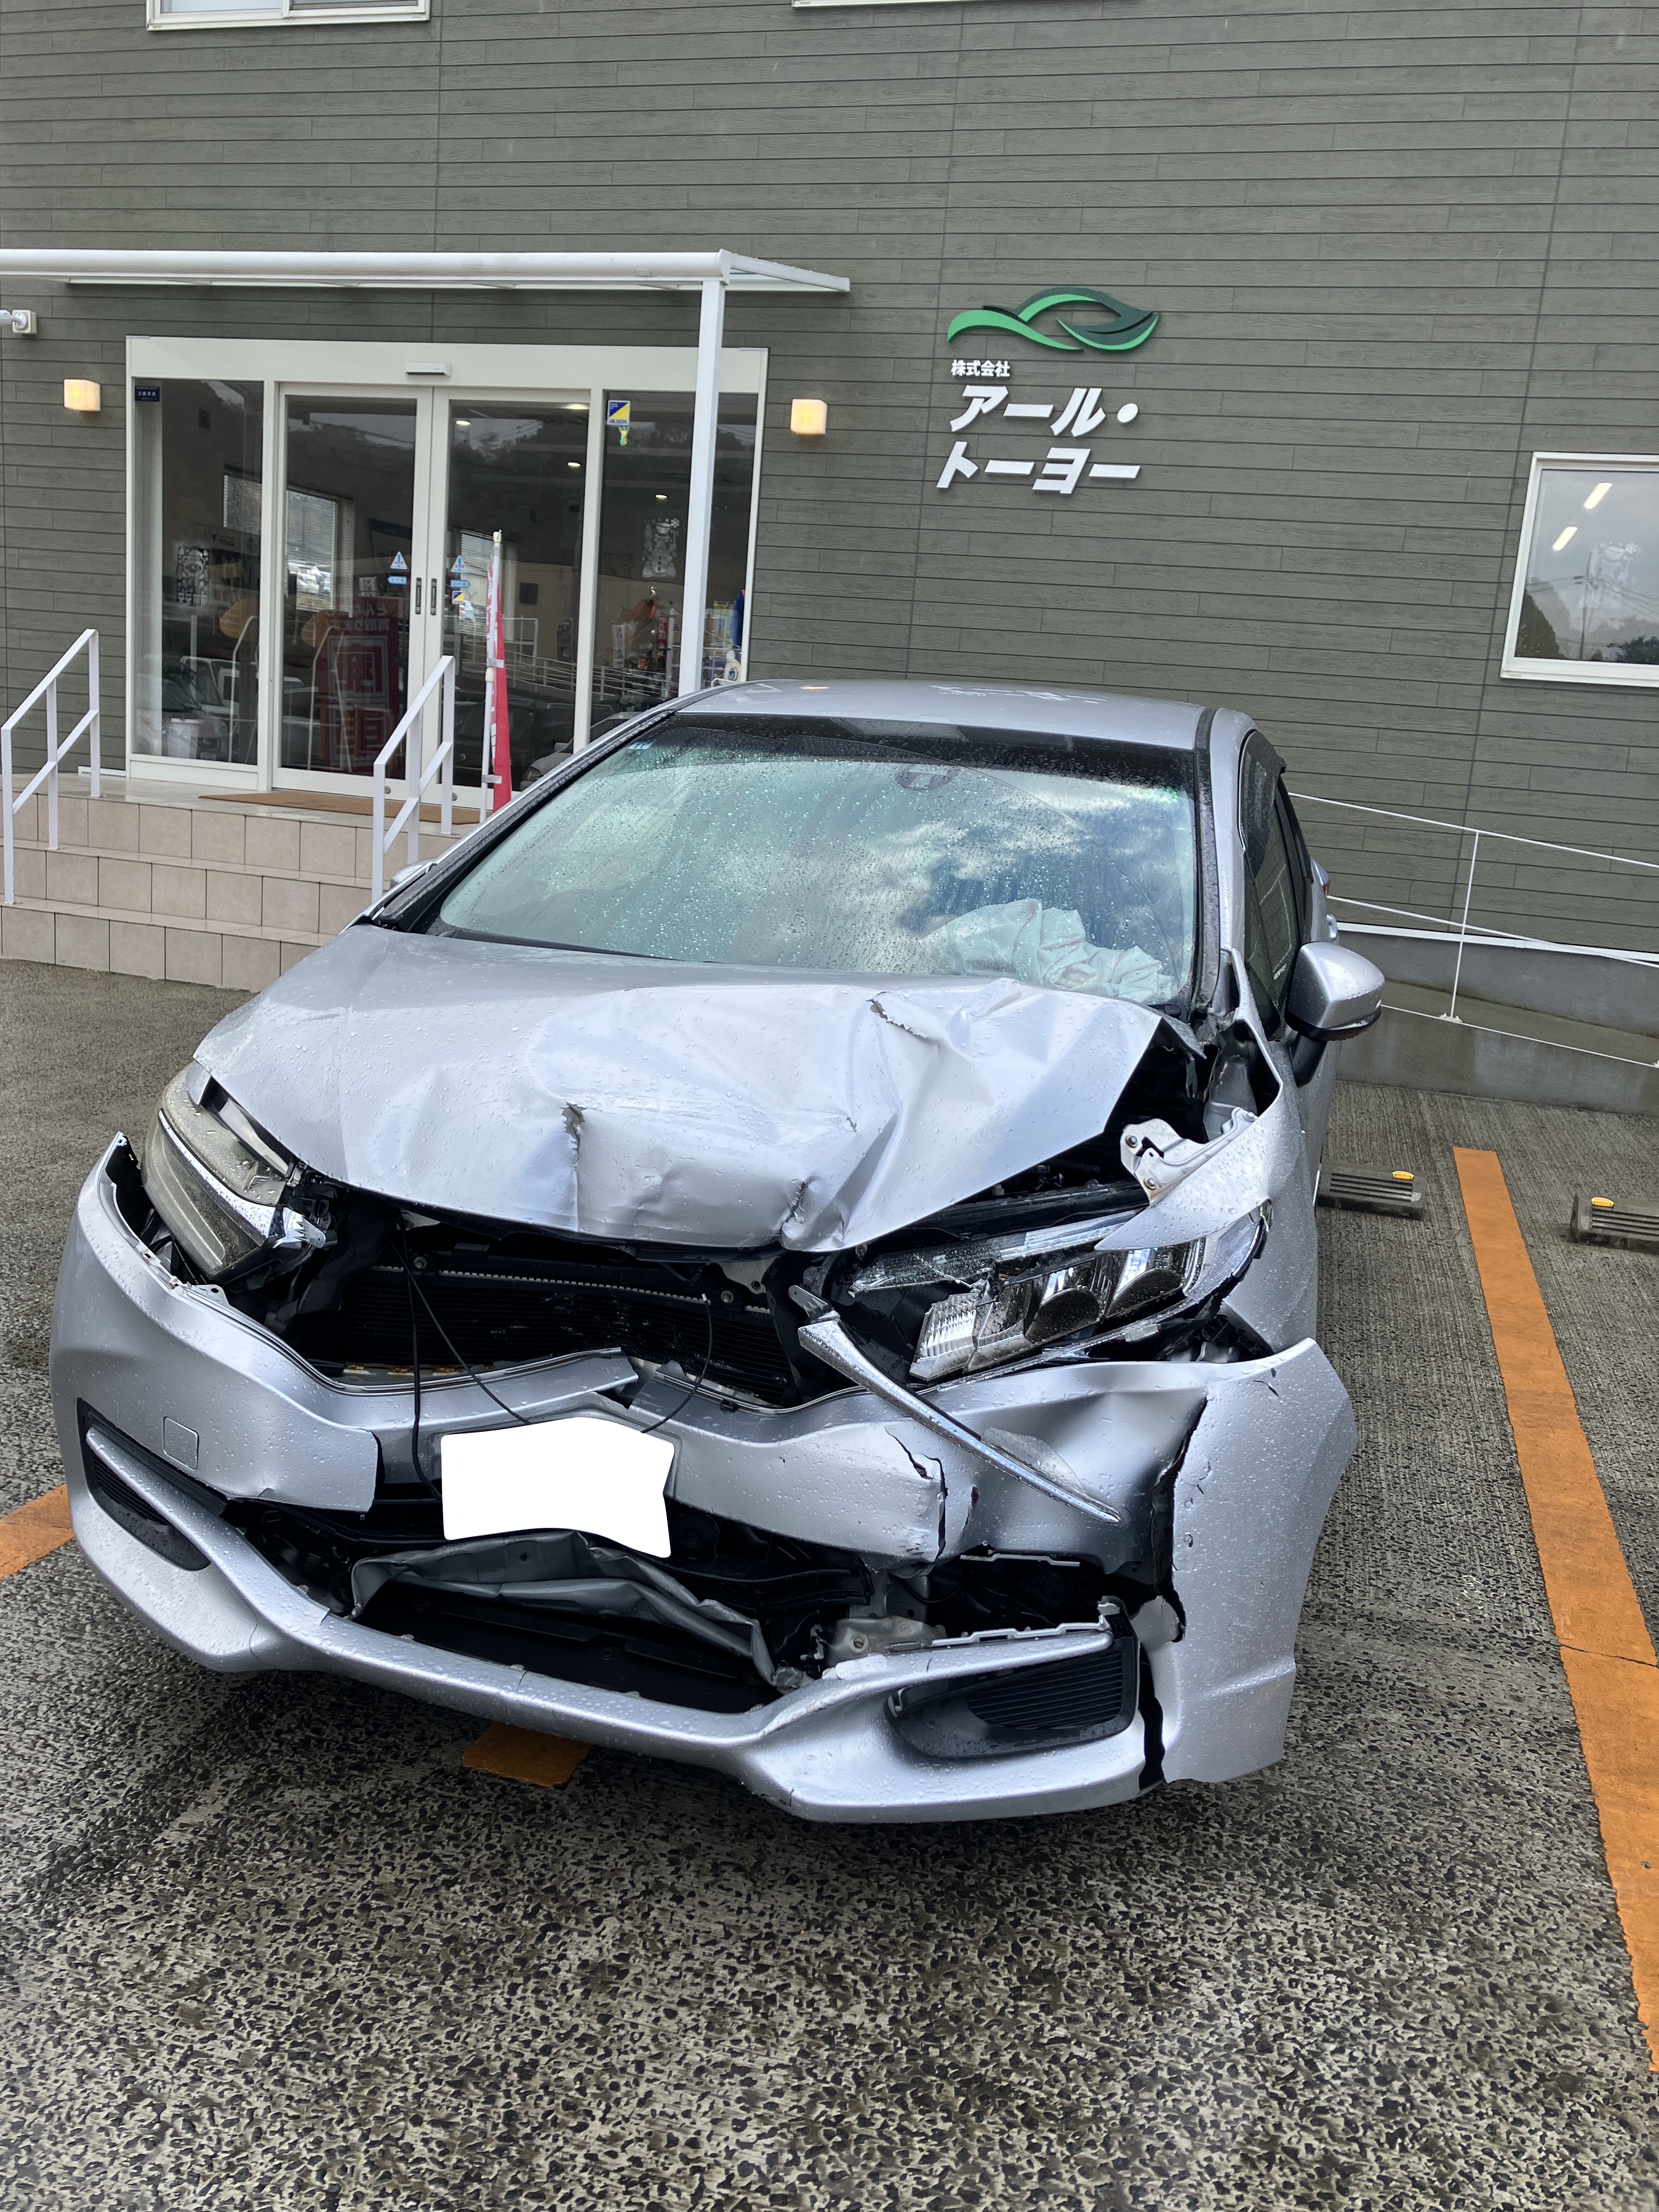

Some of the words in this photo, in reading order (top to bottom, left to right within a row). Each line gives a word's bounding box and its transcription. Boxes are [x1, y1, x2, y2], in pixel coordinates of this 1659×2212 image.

[951, 359, 1011, 377] 株式会社
[950, 385, 1138, 437] アール・
[936, 441, 1141, 494] トーヨー
